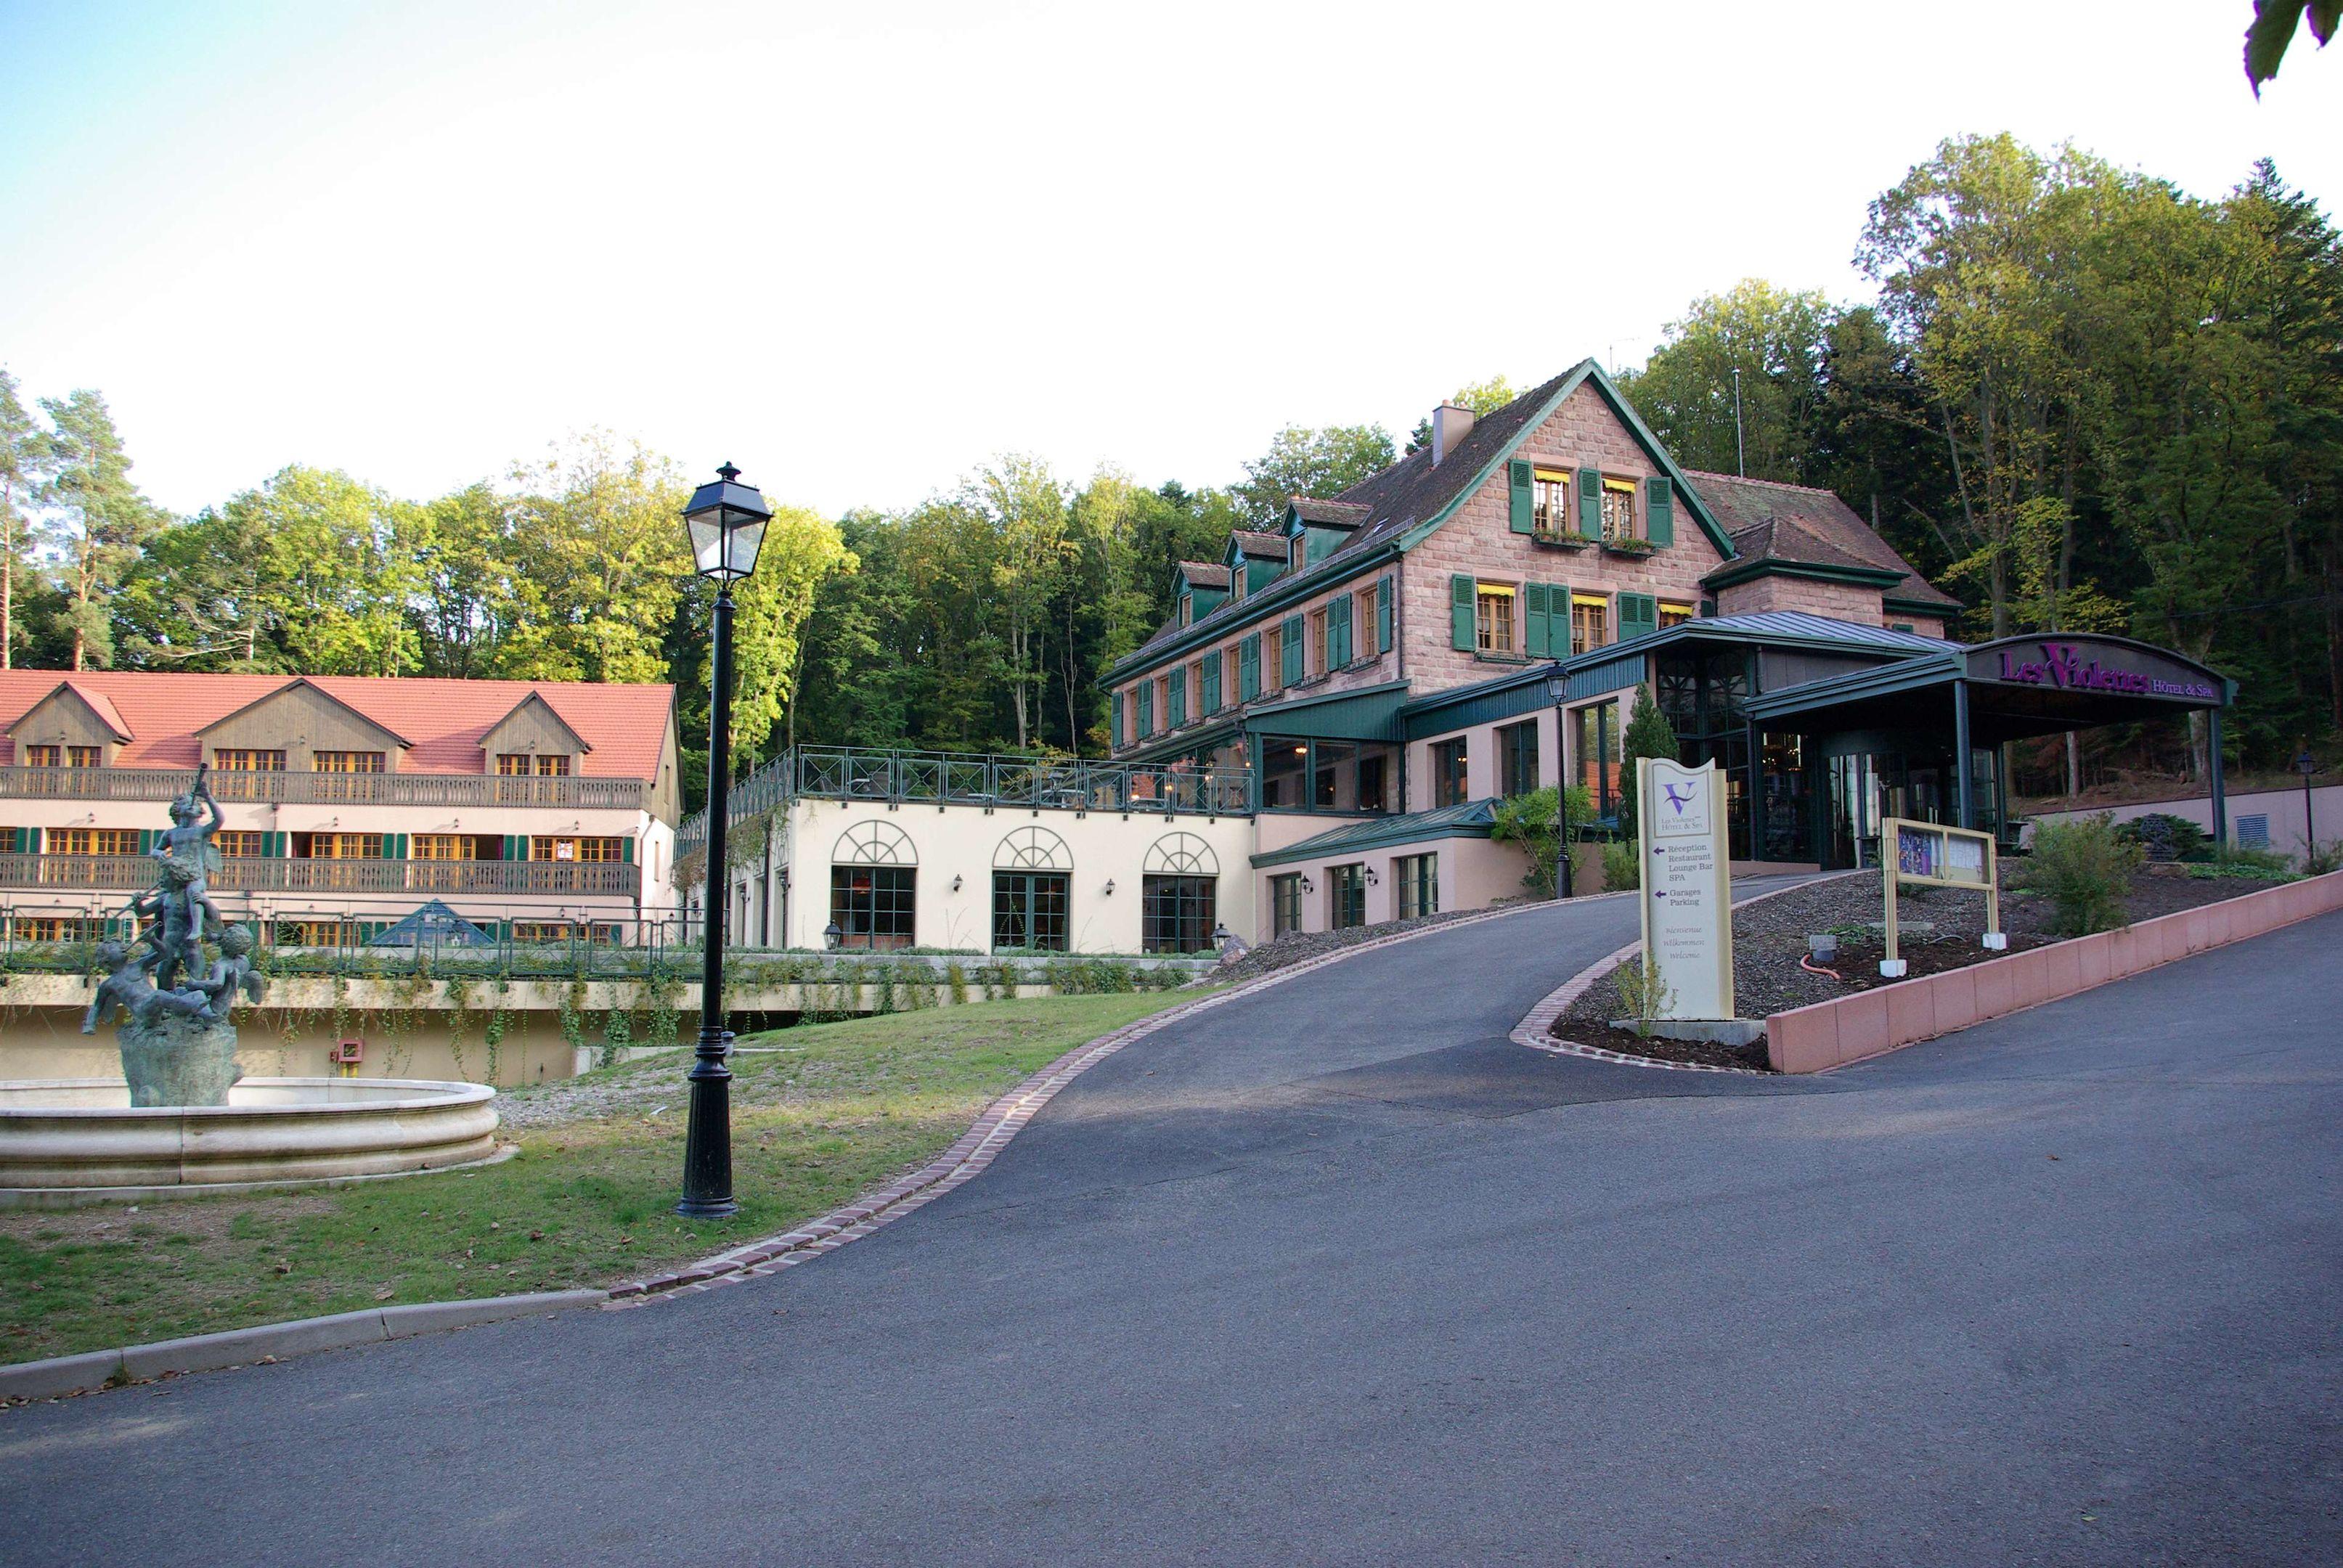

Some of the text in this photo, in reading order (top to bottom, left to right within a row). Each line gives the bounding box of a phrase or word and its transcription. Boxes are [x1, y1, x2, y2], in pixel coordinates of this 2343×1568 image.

[1999, 650, 2044, 682] Les
[2185, 683, 2196, 695] &
[1668, 853, 1712, 862] Restaurant
[1670, 898, 1700, 907] Parking
